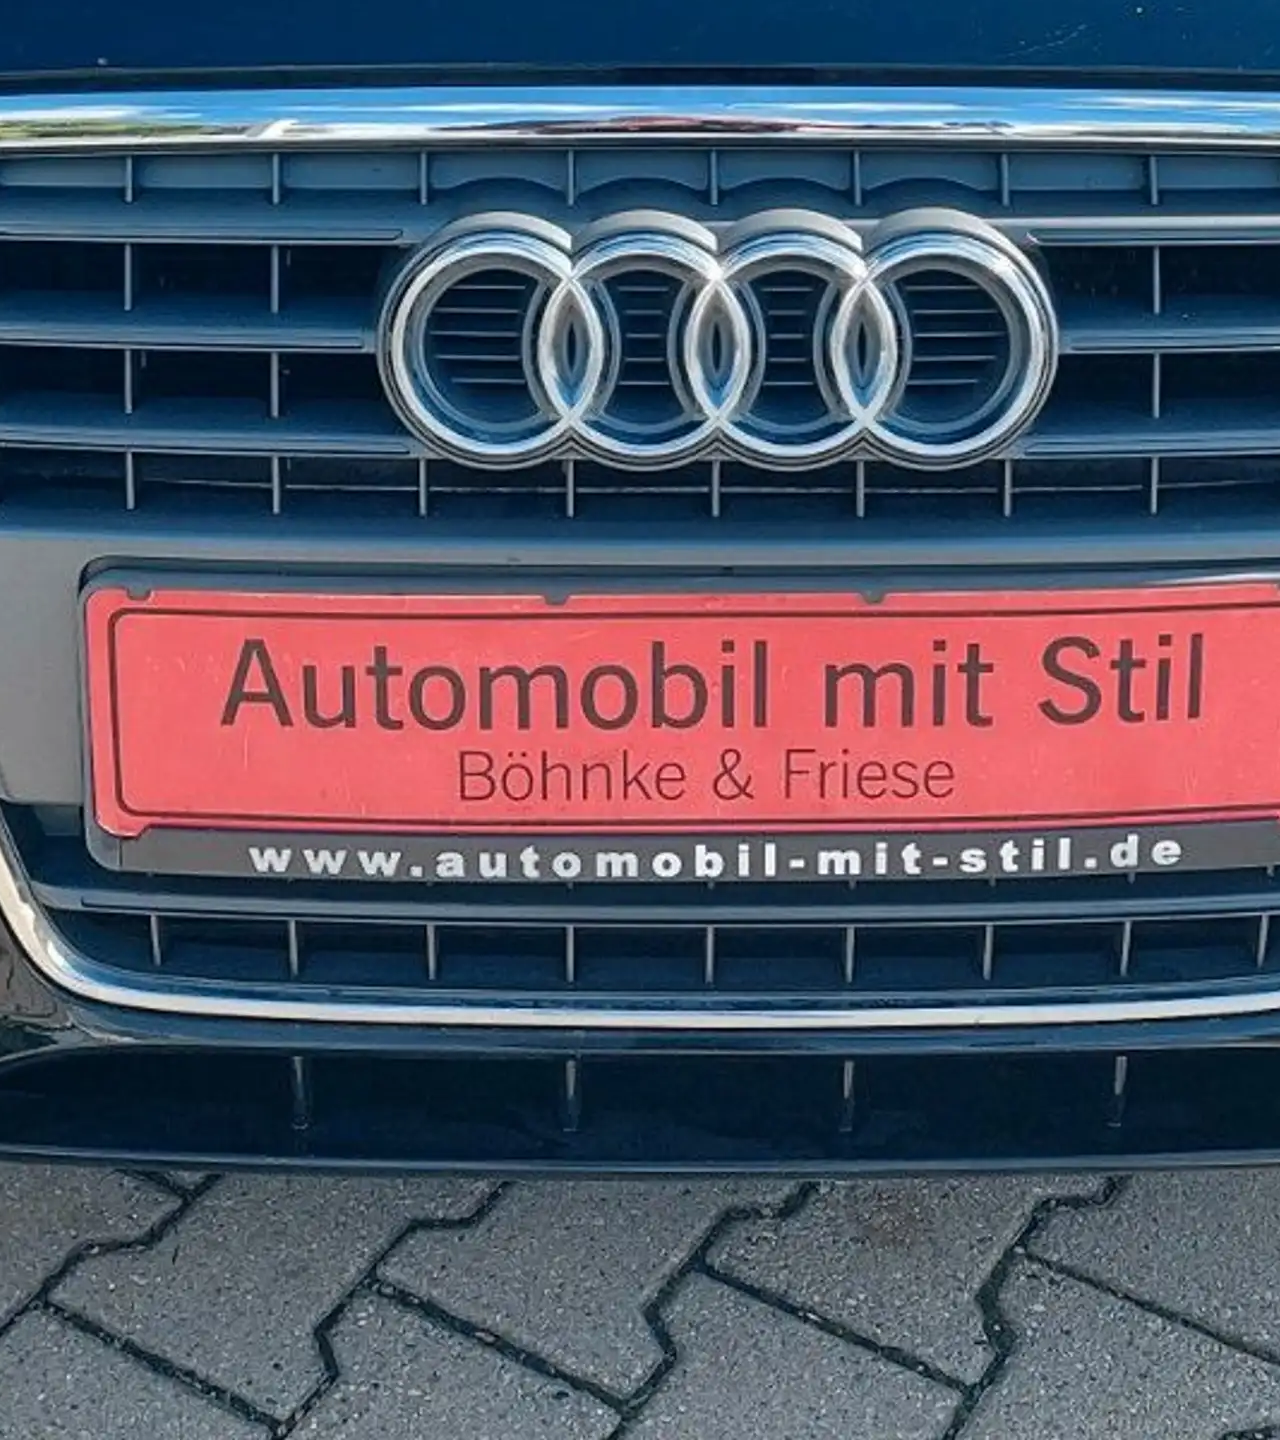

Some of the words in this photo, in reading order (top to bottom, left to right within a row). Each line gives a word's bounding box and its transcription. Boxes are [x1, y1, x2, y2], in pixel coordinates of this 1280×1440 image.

[221, 638, 768, 731] Automobil
[825, 639, 994, 728] mit
[1038, 632, 1203, 725] Stil
[459, 749, 686, 802] Böhnke
[713, 748, 754, 801] &
[785, 748, 954, 800] Friese
[248, 832, 1183, 879] www.automobil-mit-stil.de
